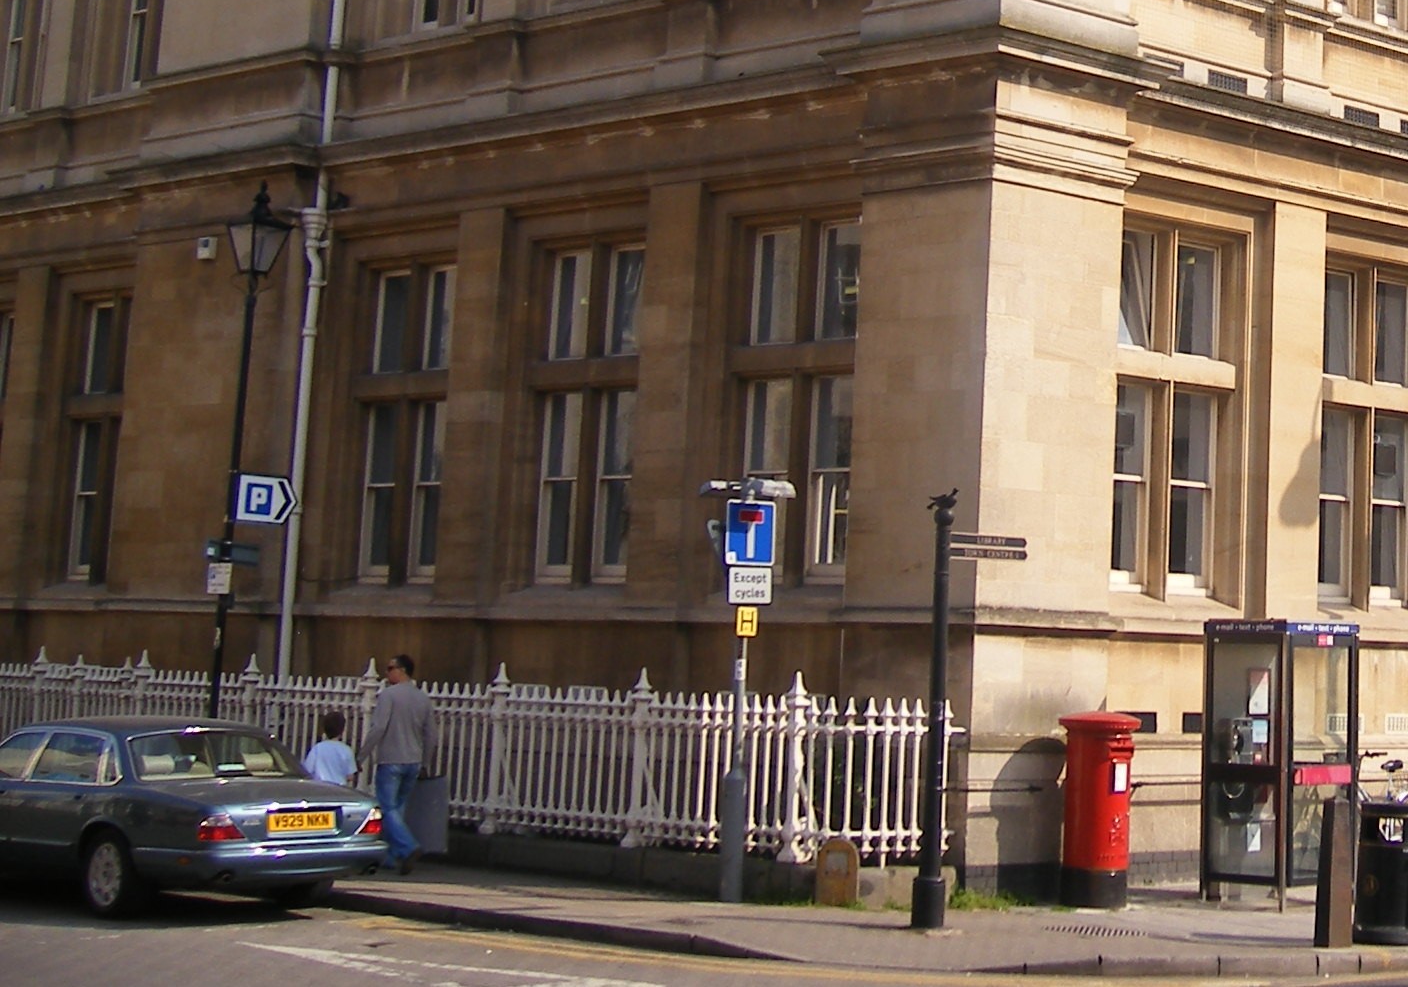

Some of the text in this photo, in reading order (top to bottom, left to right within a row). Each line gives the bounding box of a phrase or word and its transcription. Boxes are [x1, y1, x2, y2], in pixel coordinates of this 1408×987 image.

[249, 486, 268, 512] P
[734, 572, 767, 584] Except
[735, 588, 765, 600] cycles
[740, 610, 755, 632] H
[1238, 623, 1251, 631] text
[1255, 623, 1275, 633] phone
[274, 814, 304, 828] V929
[306, 812, 330, 826] NKN
